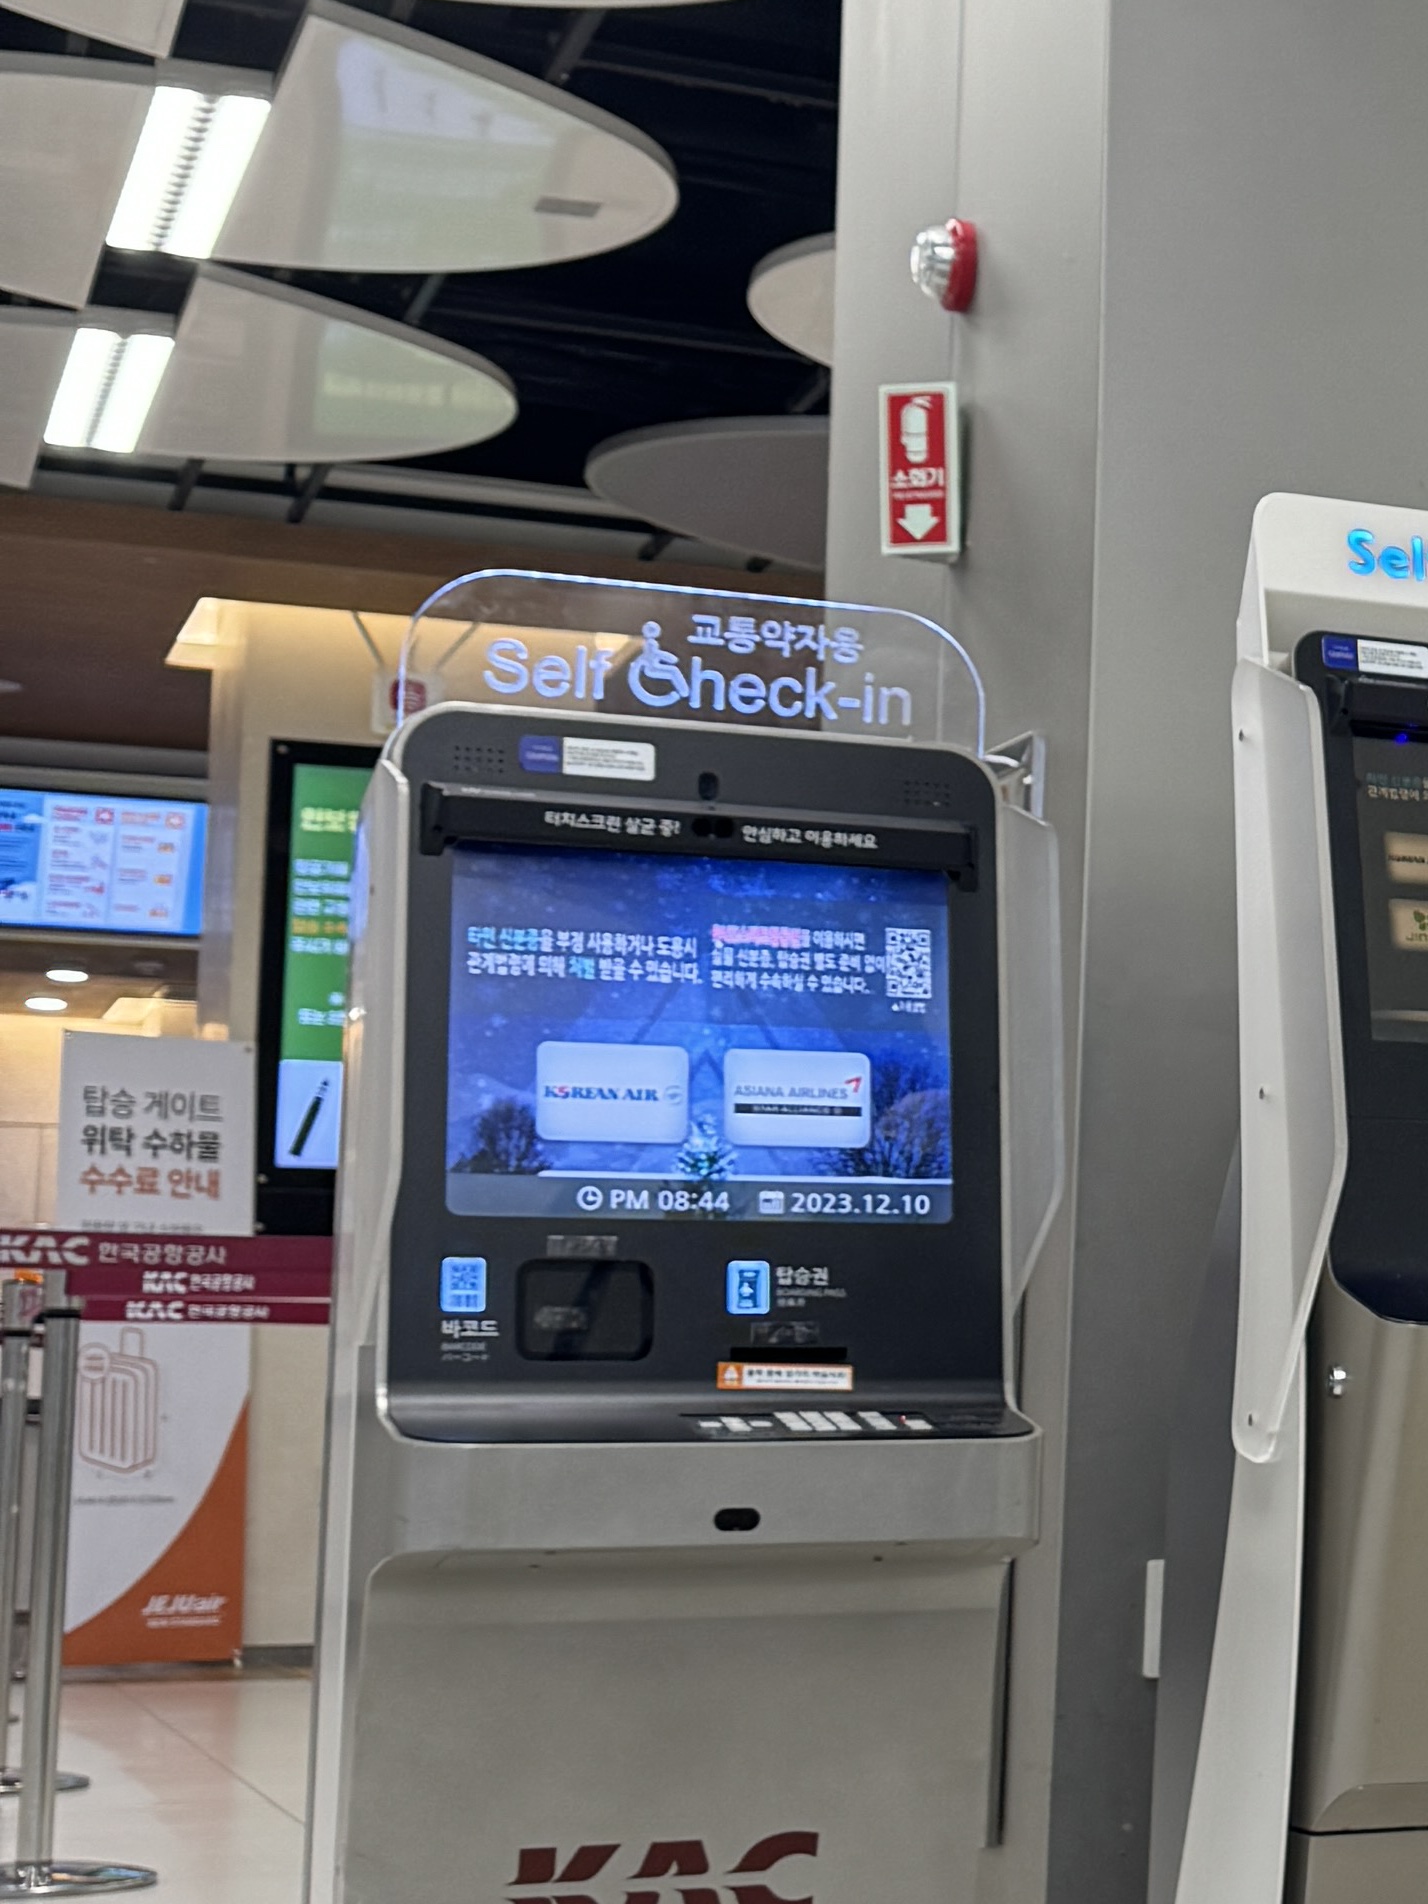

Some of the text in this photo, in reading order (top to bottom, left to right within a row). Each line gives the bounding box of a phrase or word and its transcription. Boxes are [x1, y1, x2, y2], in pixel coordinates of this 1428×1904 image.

[687, 613, 864, 664] 교통약자용
[484, 638, 613, 701] Self
[544, 810, 622, 833] 터치스크린
[625, 817, 656, 836] 살균
[741, 825, 802, 844] 안심하고
[804, 830, 878, 849] 이용하세요
[82, 1085, 223, 1123] 탑승 게이트
[543, 1084, 659, 1102] KOREAN AIR
[734, 1084, 849, 1100] ASIANA AIRLINES
[81, 1124, 222, 1163] 위탁 수하물
[79, 1163, 221, 1201] 수수료 안내
[610, 1190, 932, 1216] PM 08:44 2023.12.10
[0, 1234, 227, 1266] KAC 한국공항공사
[142, 1270, 188, 1294] KAC
[776, 1266, 830, 1286] 탑승권
[125, 1300, 185, 1320] KAC
[441, 1320, 499, 1338] 바코드
